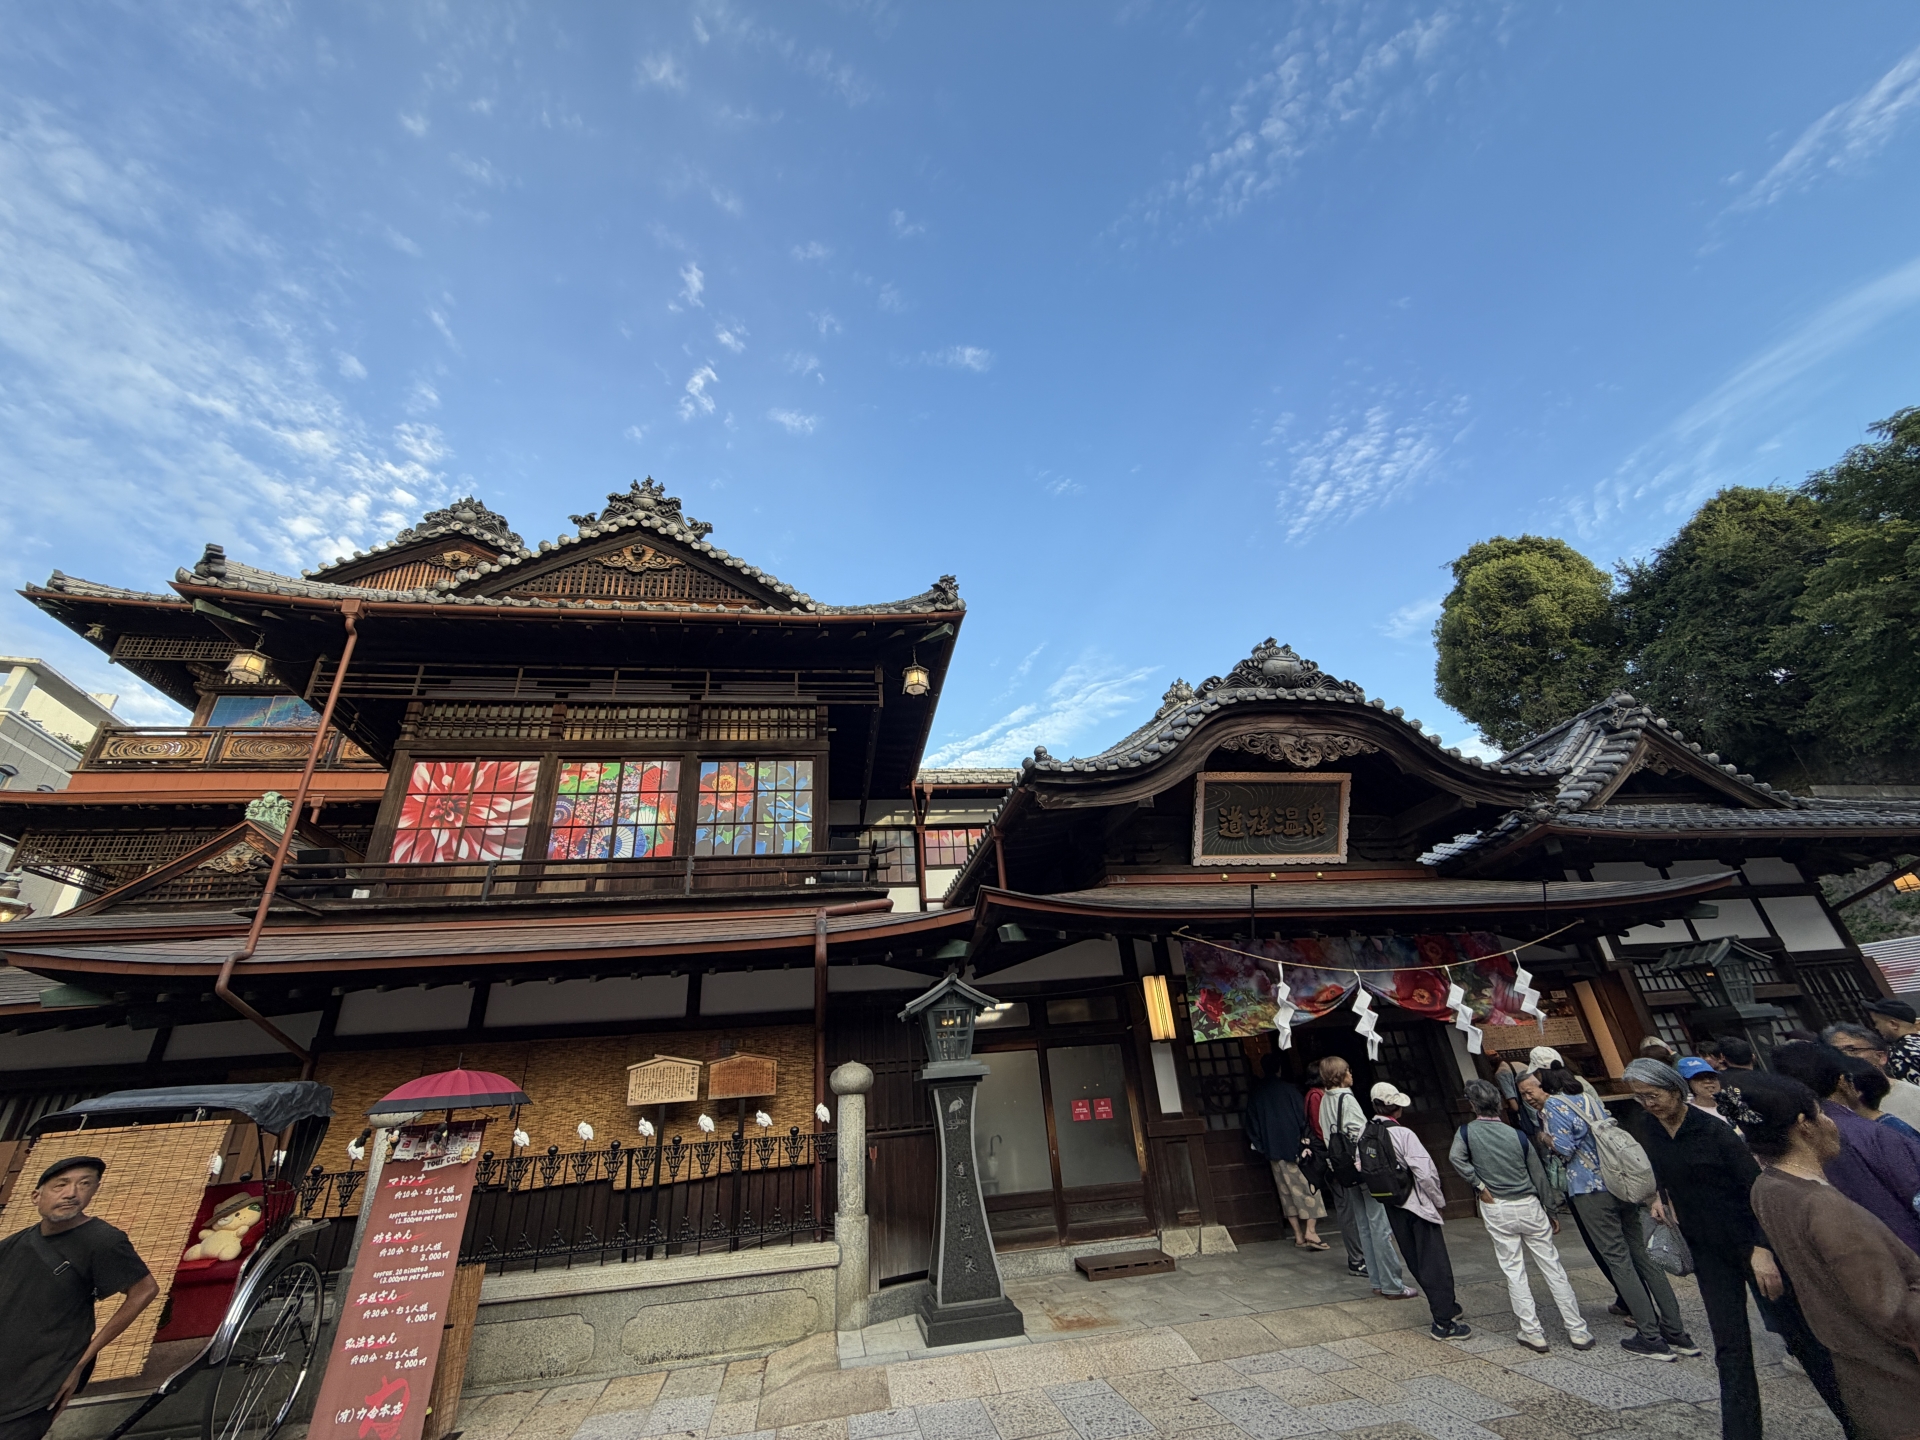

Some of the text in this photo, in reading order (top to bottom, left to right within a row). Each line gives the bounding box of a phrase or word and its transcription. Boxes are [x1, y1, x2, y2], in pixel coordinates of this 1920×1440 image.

[1218, 804, 1327, 839] 道後温泉
[389, 1173, 426, 1186] マドンナ
[953, 1161, 978, 1274] 道後温泉
[372, 1229, 412, 1244] 坊ちゃん
[356, 1289, 397, 1305] 子規さん
